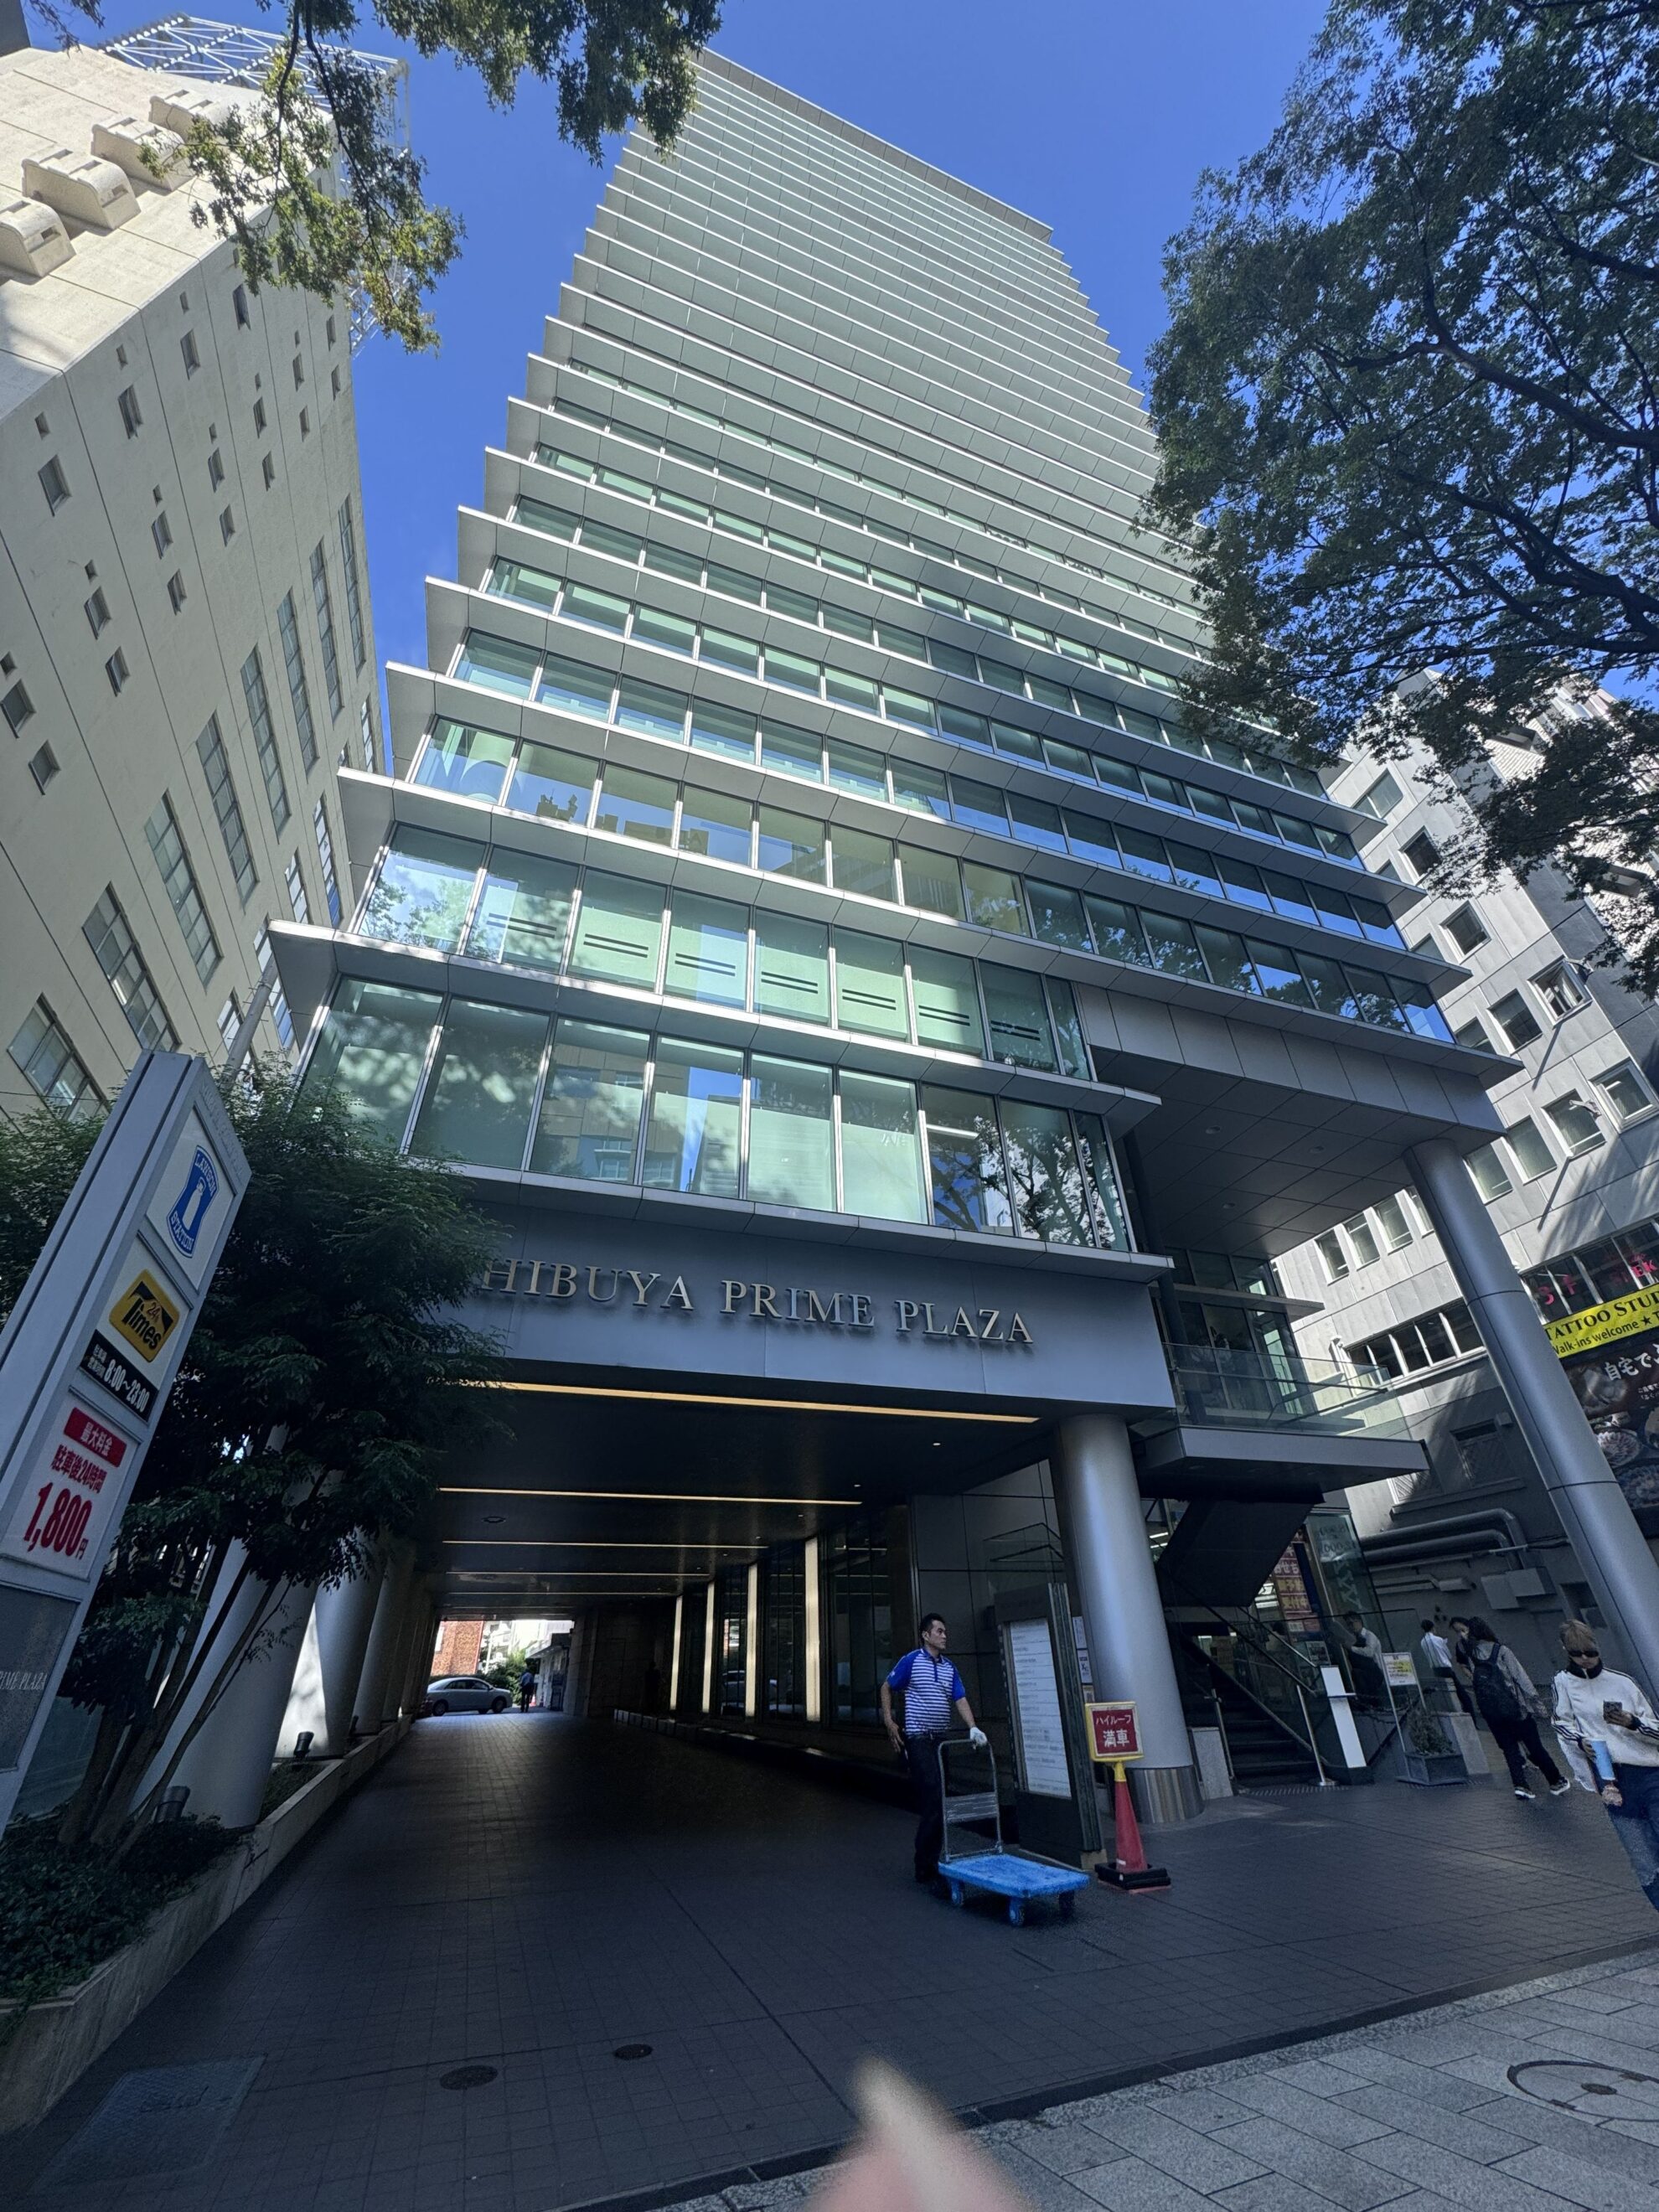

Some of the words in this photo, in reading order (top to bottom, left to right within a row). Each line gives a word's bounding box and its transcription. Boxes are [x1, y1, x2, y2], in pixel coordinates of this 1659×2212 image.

[194, 1153, 218, 1196] LAWSON
[169, 1209, 195, 1252] STATION
[481, 1258, 695, 1311] HIBUYA
[719, 1279, 875, 1327] PRIME
[894, 1300, 1033, 1344] PLAZA
[121, 1297, 162, 1350] Times
[1544, 1310, 1611, 1341] TATTOO
[1591, 1321, 1640, 1341] welcome
[1095, 1714, 1132, 1726] ハイルーフ
[1103, 1729, 1130, 1748] 満車
